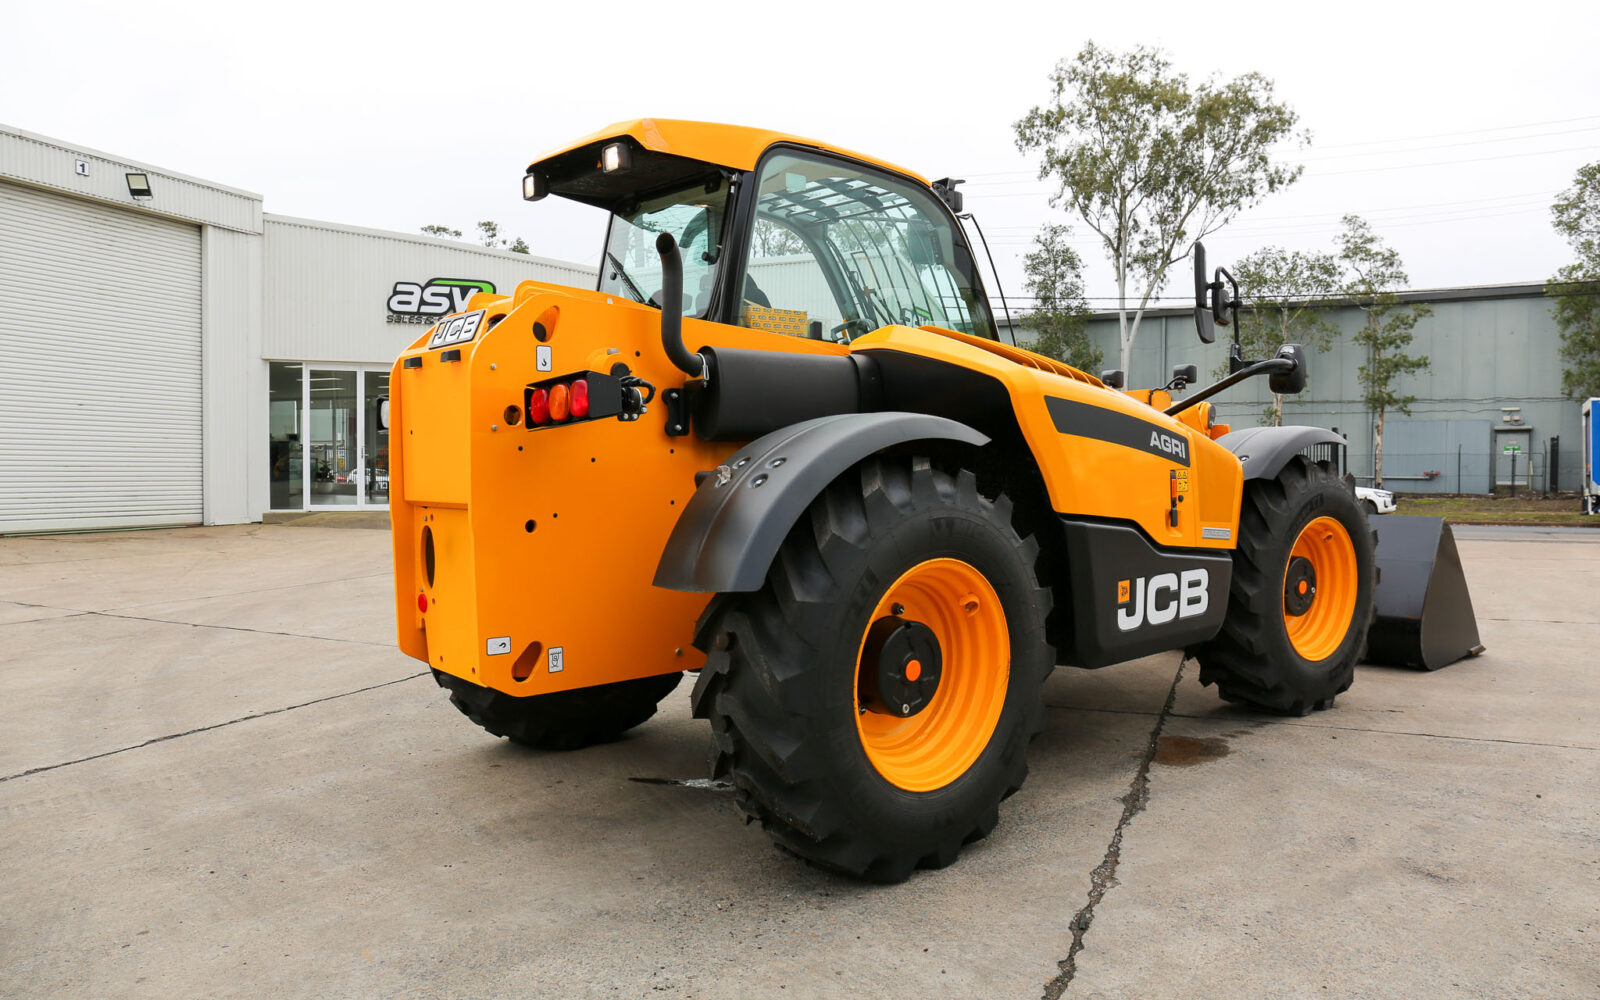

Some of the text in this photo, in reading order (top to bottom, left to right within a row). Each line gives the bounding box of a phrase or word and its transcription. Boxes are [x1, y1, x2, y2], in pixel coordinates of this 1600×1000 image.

[79, 163, 86, 173] 1
[431, 313, 481, 346] JCB
[1149, 431, 1186, 459] AGRI
[1117, 569, 1209, 631] JCB
